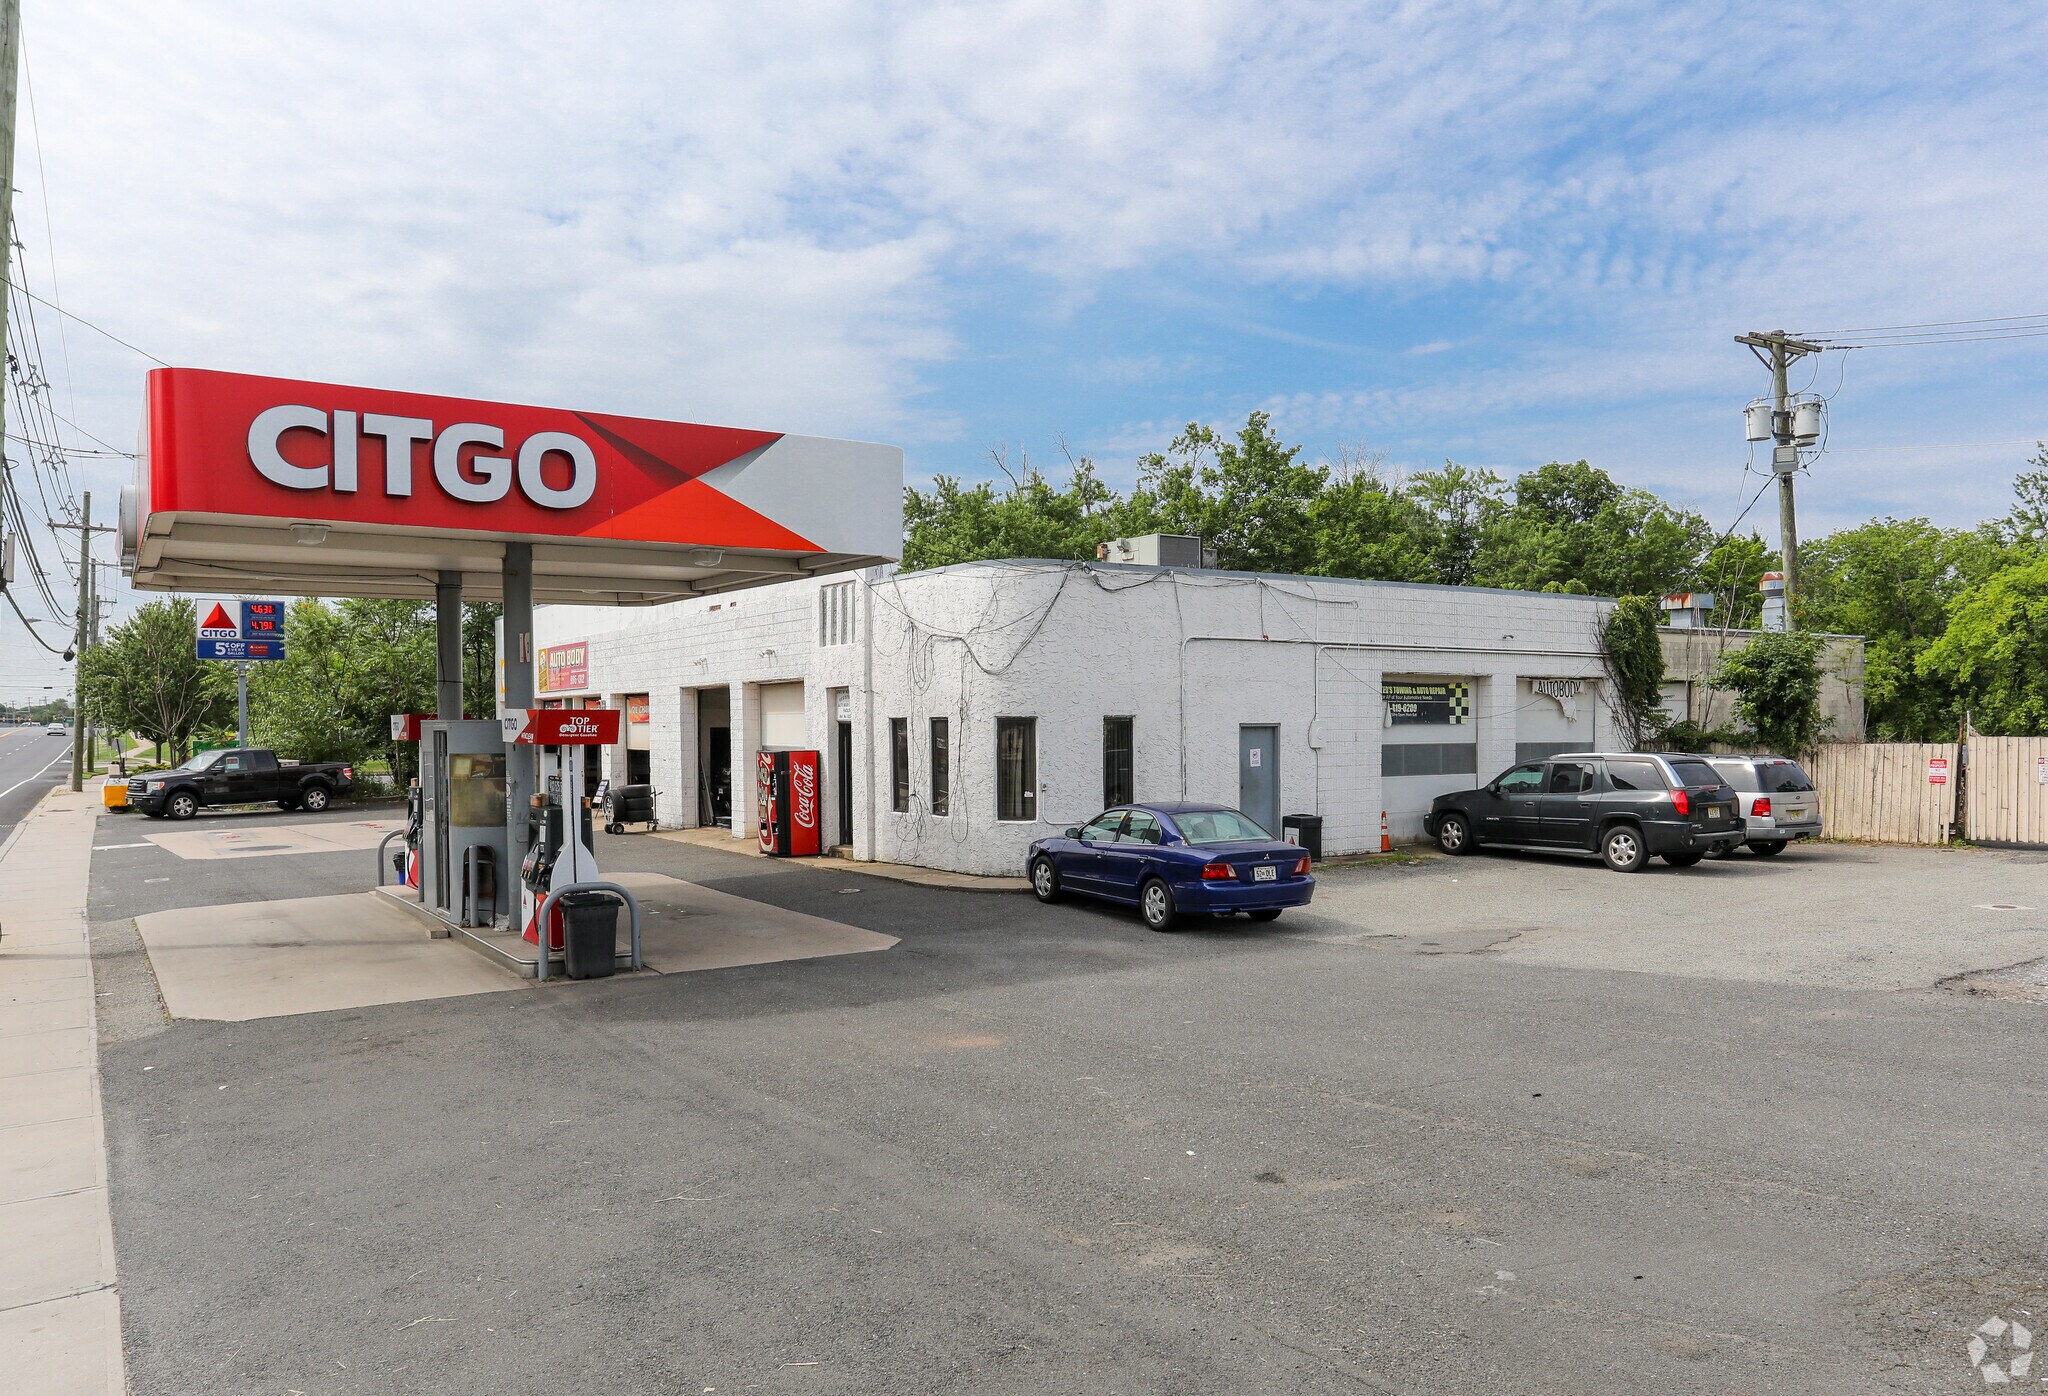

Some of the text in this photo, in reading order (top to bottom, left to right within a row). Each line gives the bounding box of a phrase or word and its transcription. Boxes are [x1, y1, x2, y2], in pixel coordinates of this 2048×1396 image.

[247, 404, 597, 509] CITGO
[201, 630, 237, 638] CITGO
[549, 646, 585, 669] AUTO BODY
[1429, 687, 1446, 695] REPAIR
[1538, 680, 1580, 697] AUTOBODY
[570, 717, 590, 725] TOP
[793, 760, 815, 828] Coca-Cola
